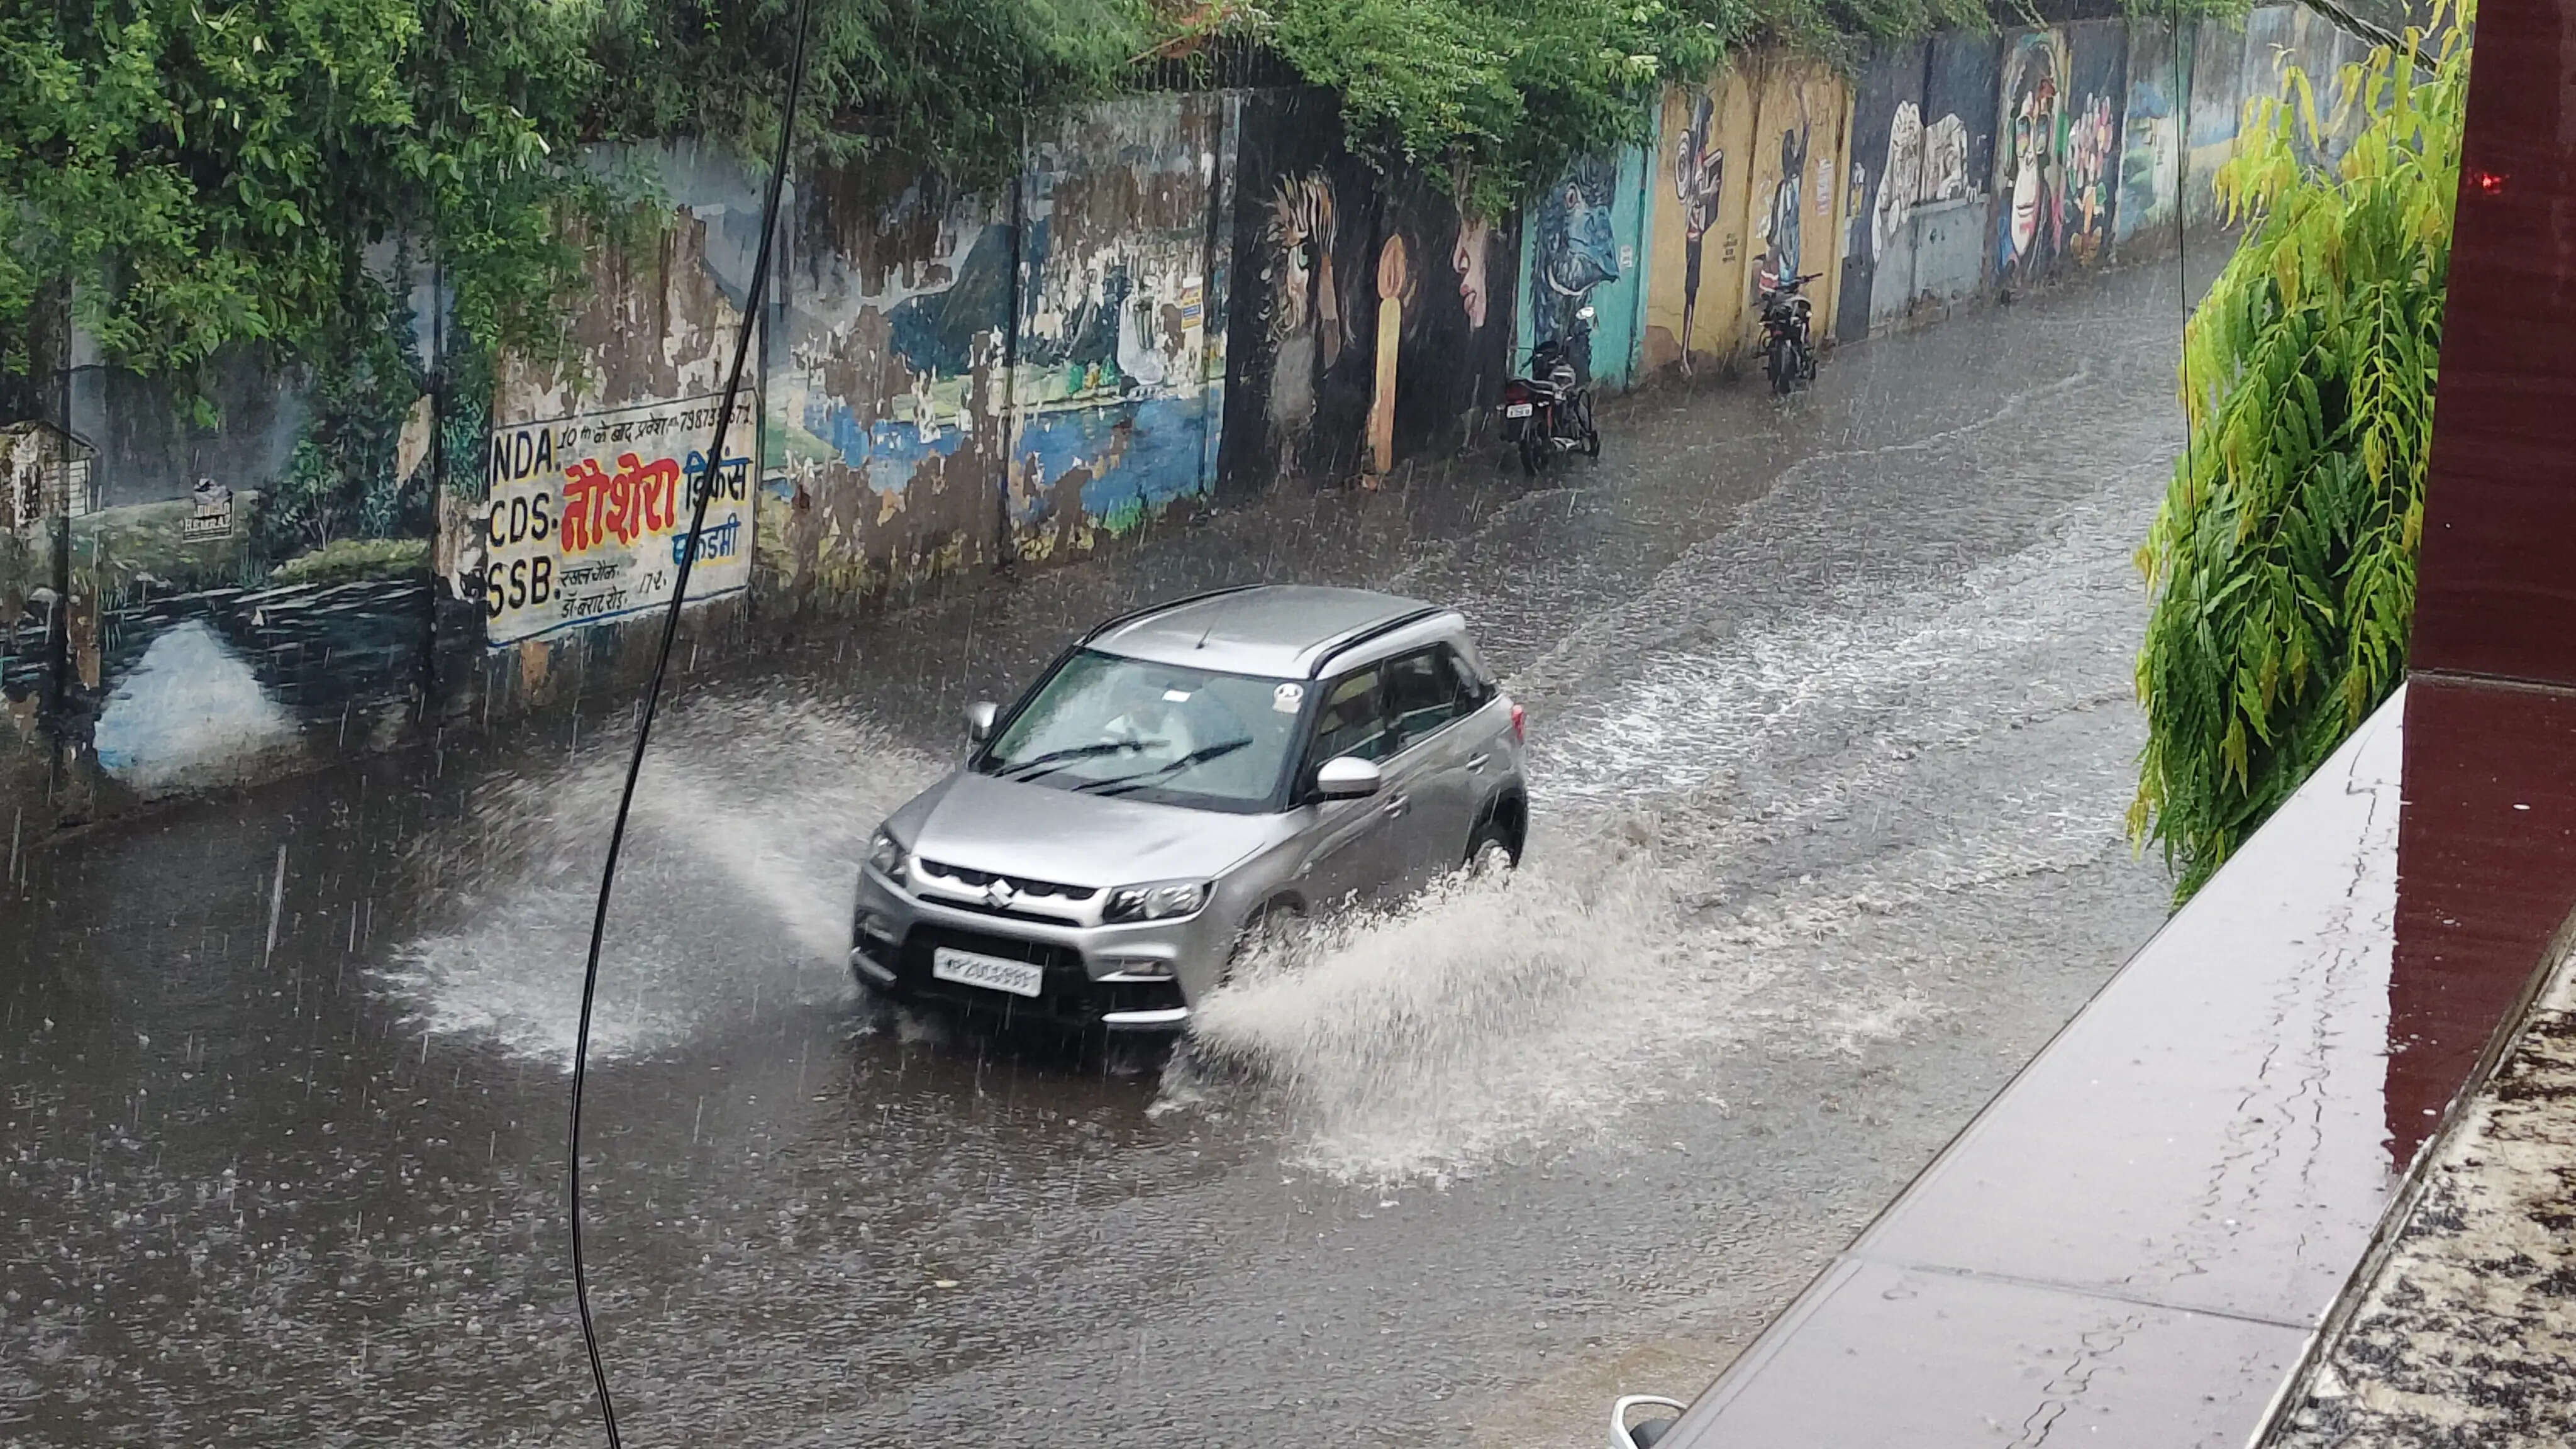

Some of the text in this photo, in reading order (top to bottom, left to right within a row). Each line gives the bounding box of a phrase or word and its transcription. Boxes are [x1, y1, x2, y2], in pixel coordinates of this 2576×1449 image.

[492, 428, 562, 487] NDA.
[490, 492, 558, 547] CDS.
[487, 555, 561, 619] SSB.
